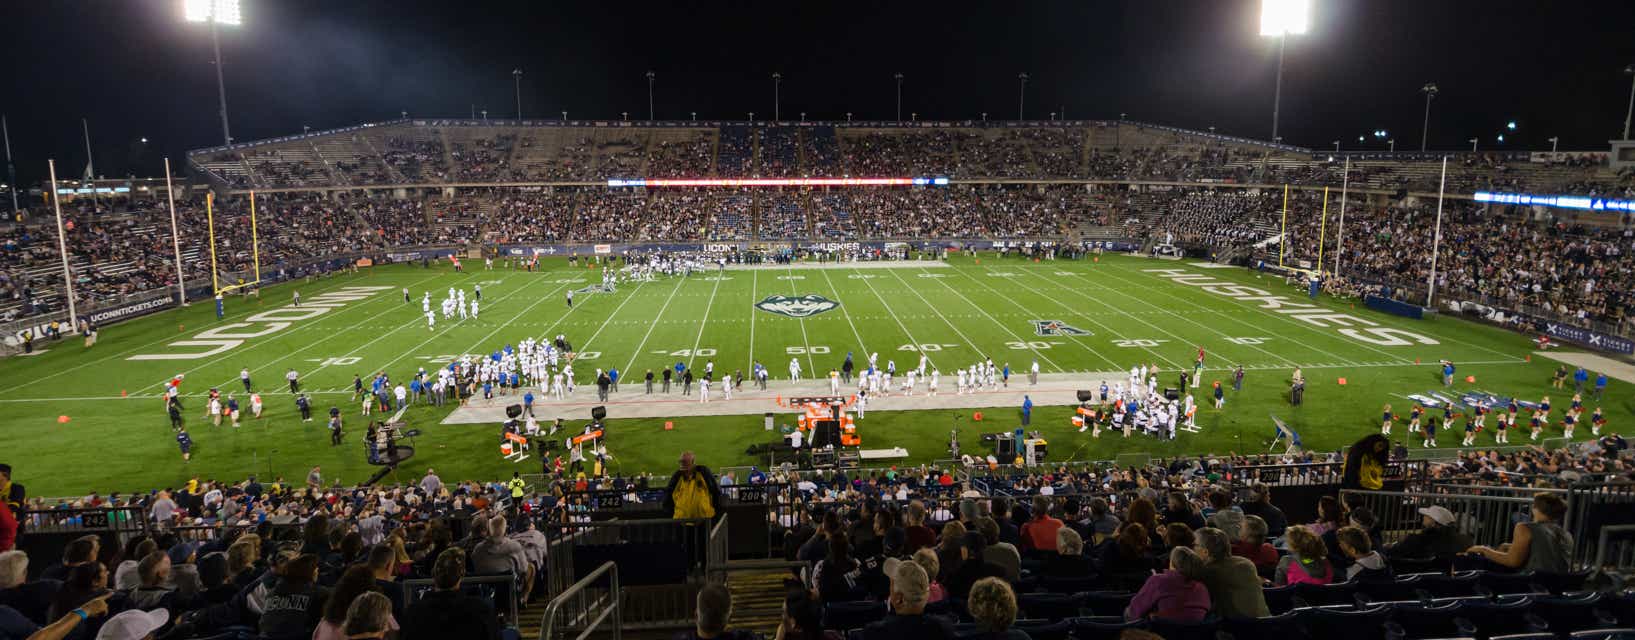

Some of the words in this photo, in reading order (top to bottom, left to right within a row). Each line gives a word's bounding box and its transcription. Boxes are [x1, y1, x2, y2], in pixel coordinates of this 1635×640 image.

[125, 286, 397, 361] UCONN
[1141, 269, 1440, 346] HUSKIES
[786, 346, 831, 354] 50
